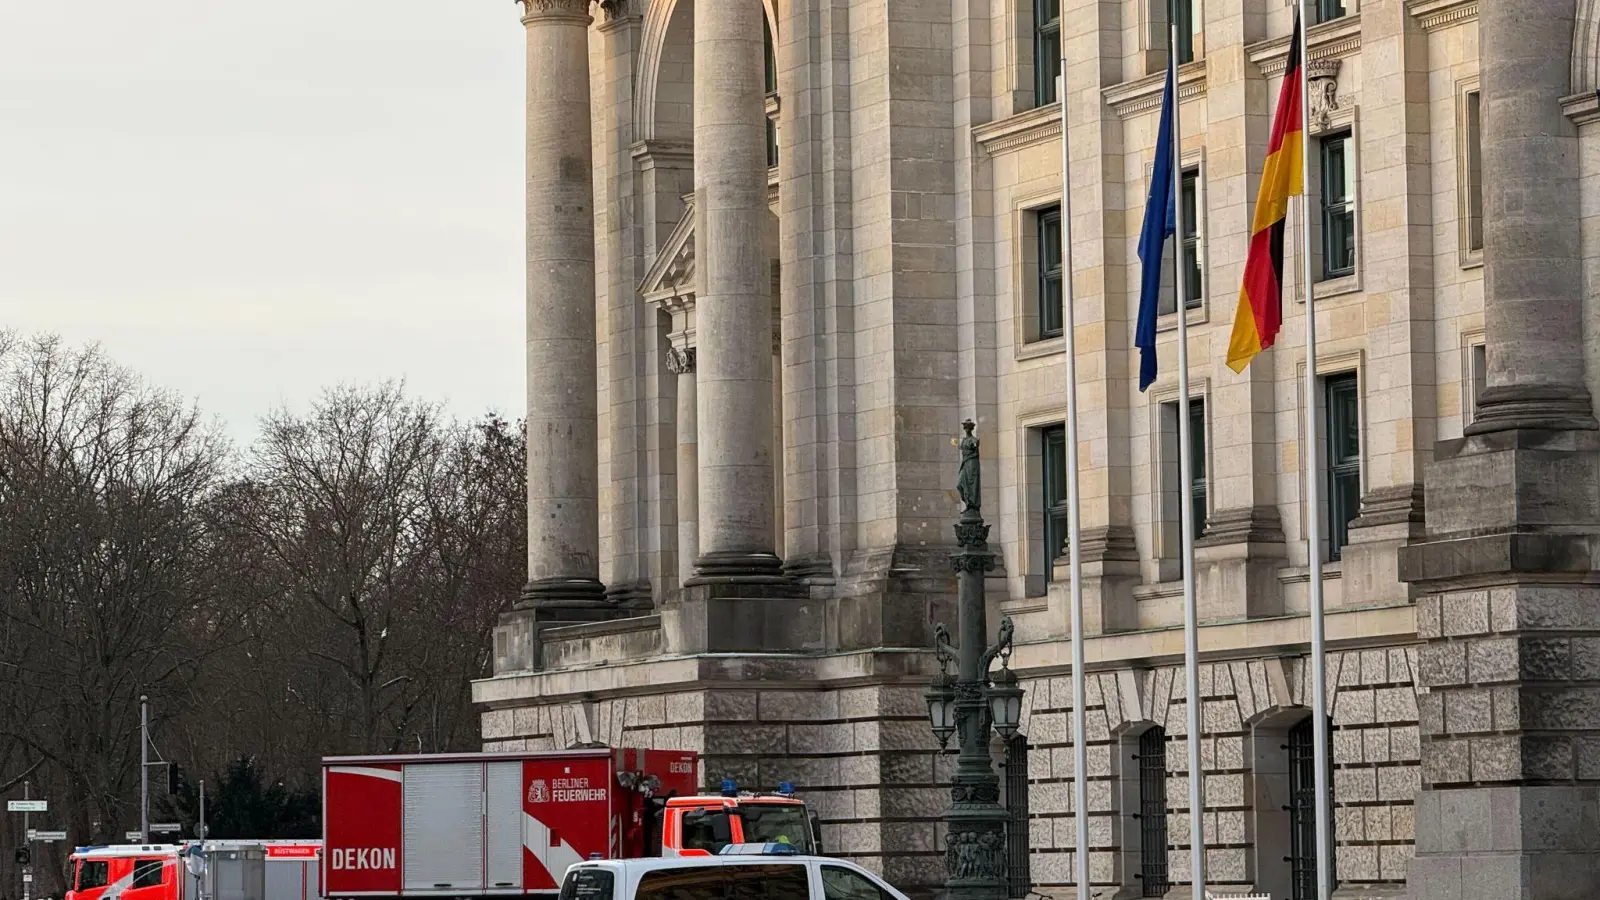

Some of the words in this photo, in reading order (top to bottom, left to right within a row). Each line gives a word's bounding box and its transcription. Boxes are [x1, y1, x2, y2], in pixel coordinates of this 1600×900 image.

[670, 762, 692, 773] DEKON
[552, 778, 589, 789] BERLINER
[552, 789, 606, 802] FEUERWEHR
[332, 848, 396, 870] DEKON
